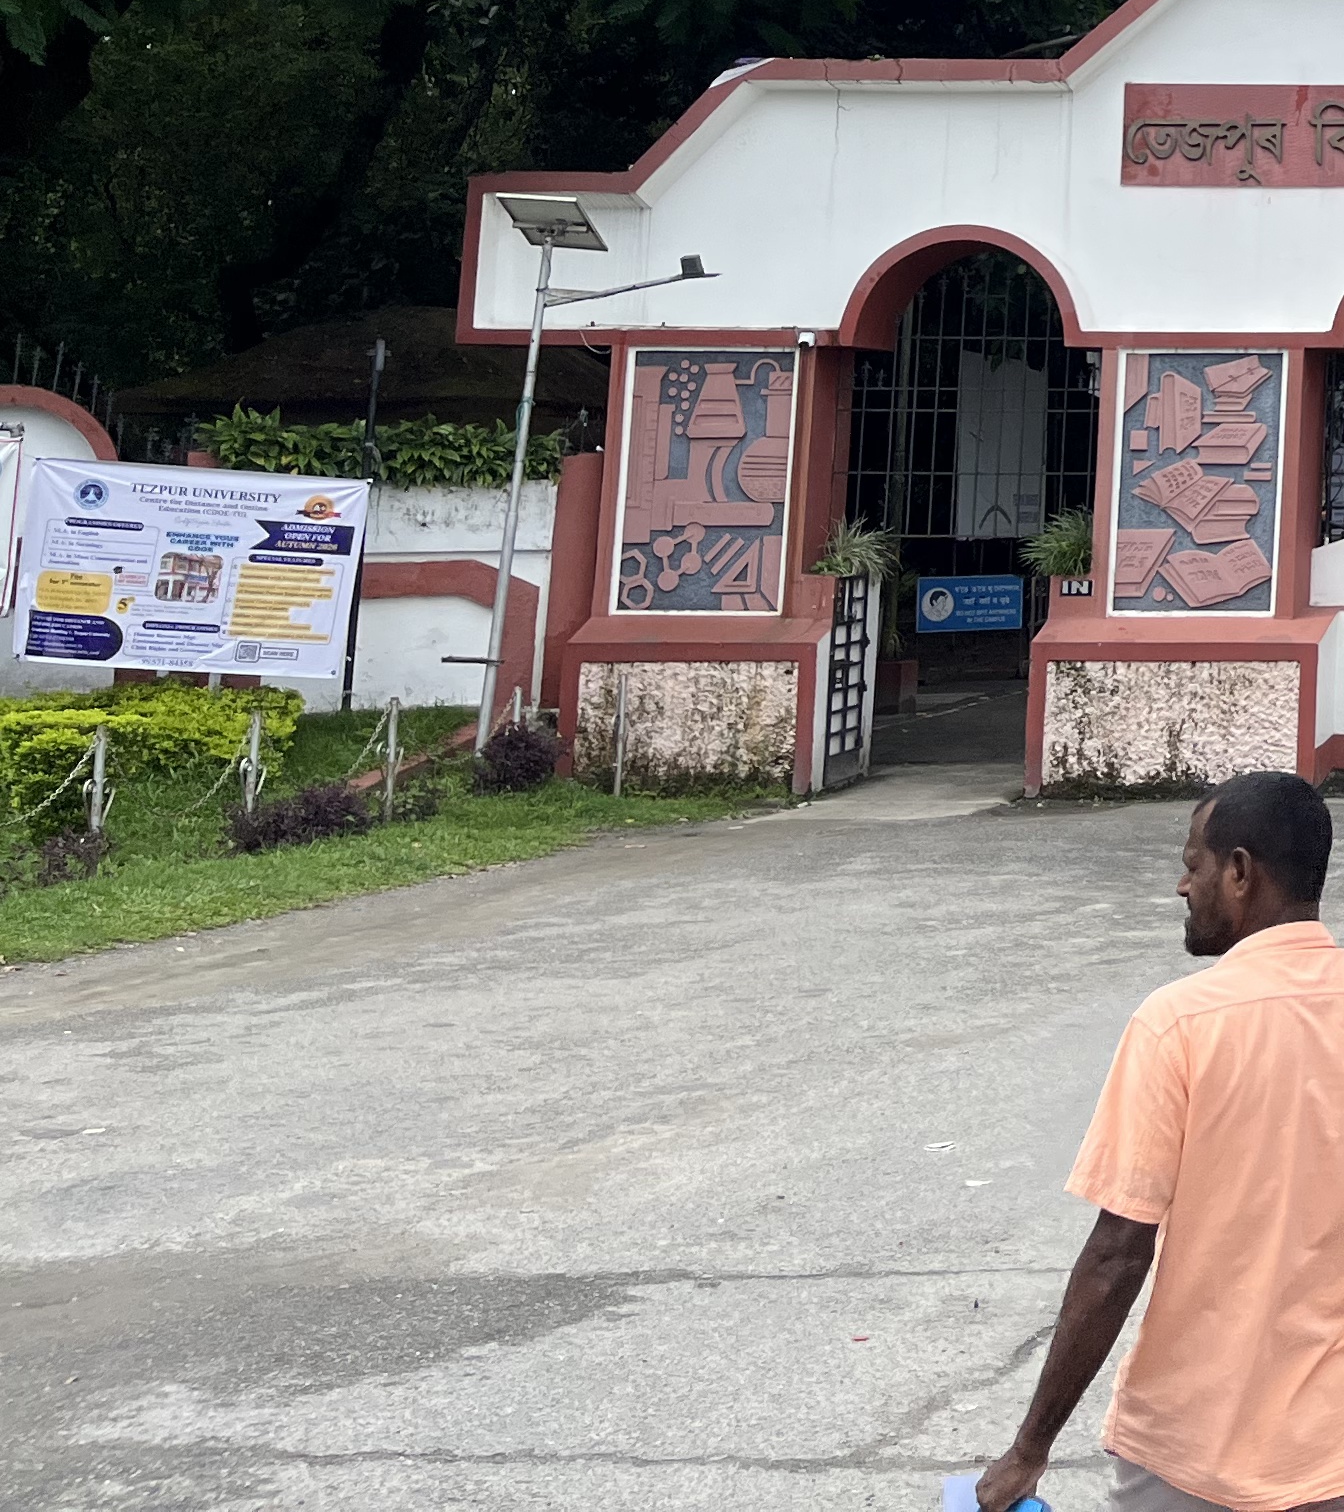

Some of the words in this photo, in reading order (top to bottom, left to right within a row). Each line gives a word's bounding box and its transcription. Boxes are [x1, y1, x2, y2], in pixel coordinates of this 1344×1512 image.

[1127, 113, 1287, 184] তেজপুৰ
[131, 482, 188, 497] TEZPUR
[192, 487, 281, 504] UNIVERSITY
[185, 499, 220, 509] Distance
[222, 502, 238, 510] and
[281, 523, 336, 534] ADMISSION
[166, 531, 211, 541] ENHANCE
[284, 533, 310, 542] OPEN
[311, 534, 332, 543] FOR
[276, 540, 316, 550] AUTUMN
[1062, 580, 1089, 594] IN
